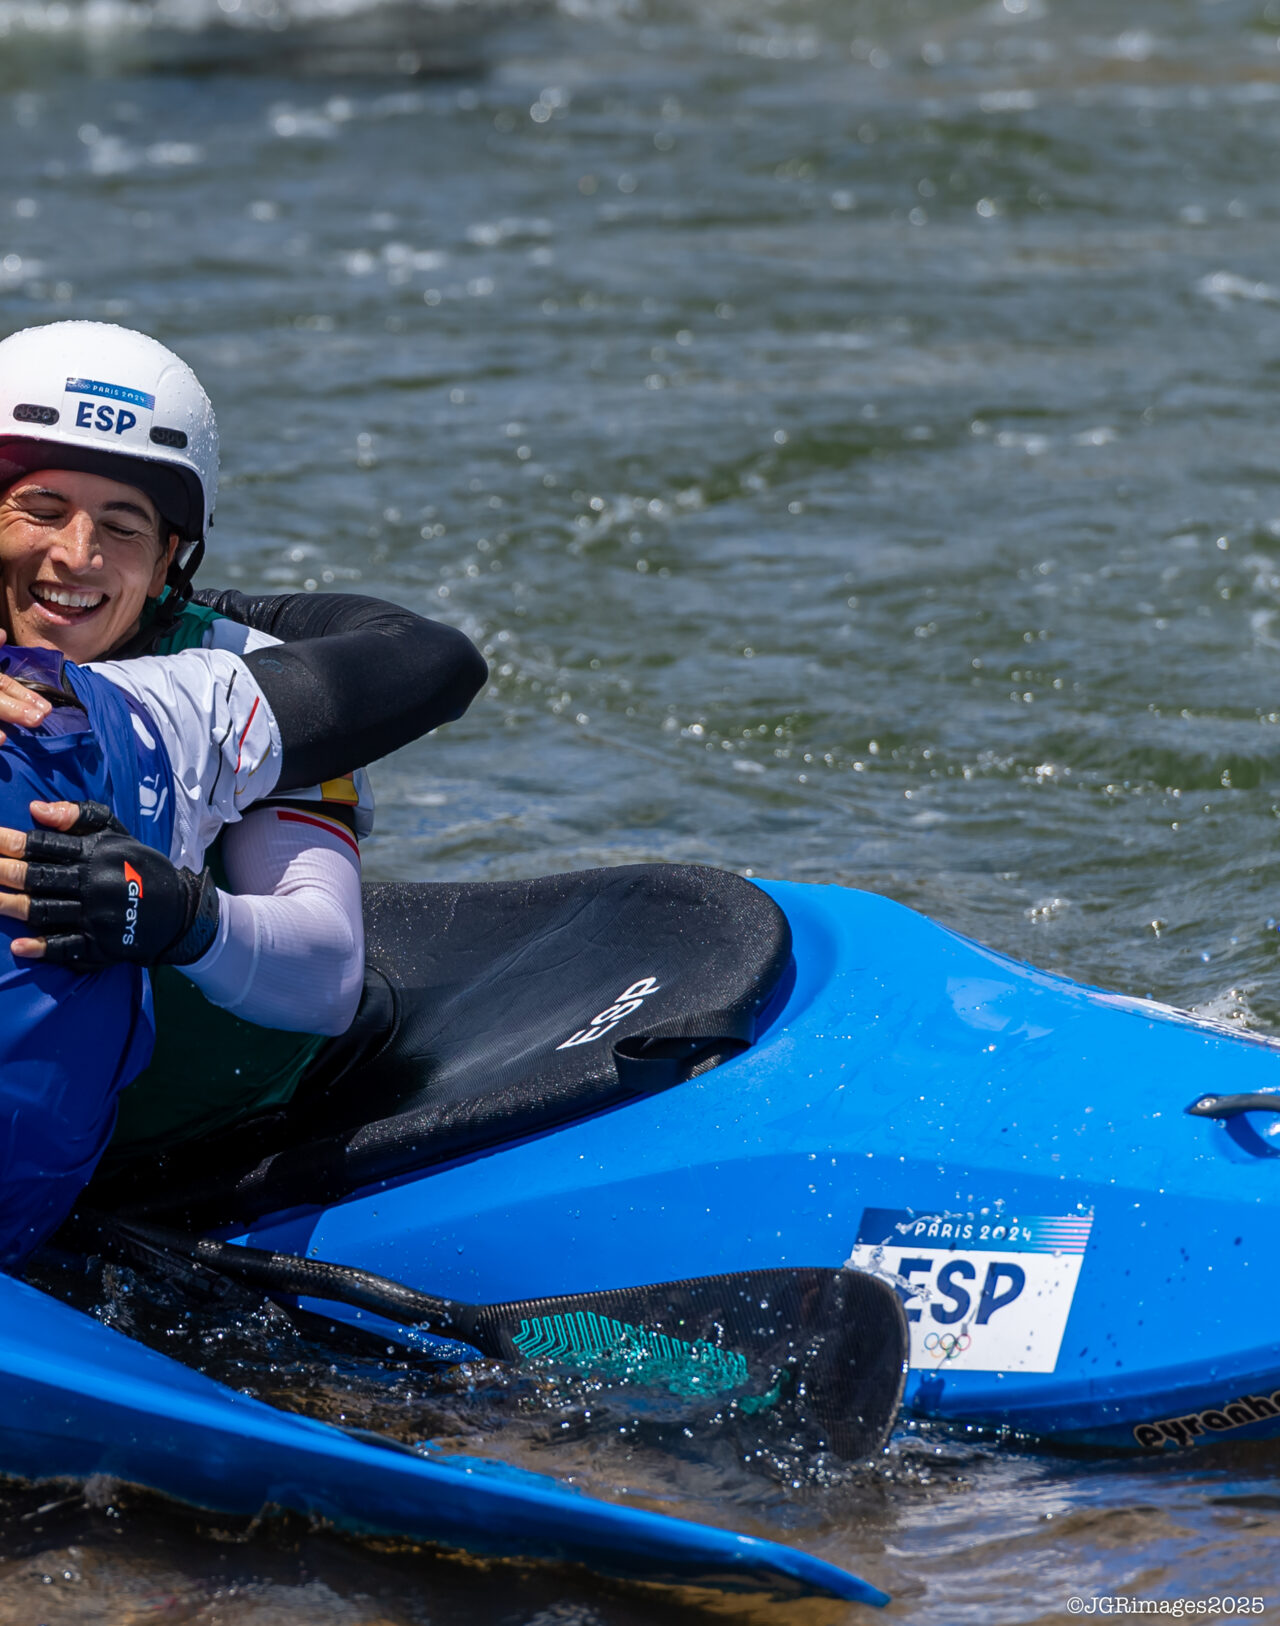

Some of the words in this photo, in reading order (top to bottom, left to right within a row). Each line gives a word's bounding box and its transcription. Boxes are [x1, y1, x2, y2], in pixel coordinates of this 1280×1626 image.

[75, 400, 137, 436] ESP
[122, 881, 140, 945] Grays
[555, 976, 661, 1051] ESP
[979, 1225, 1032, 1242] 2024
[894, 1256, 1026, 1326] ESP
